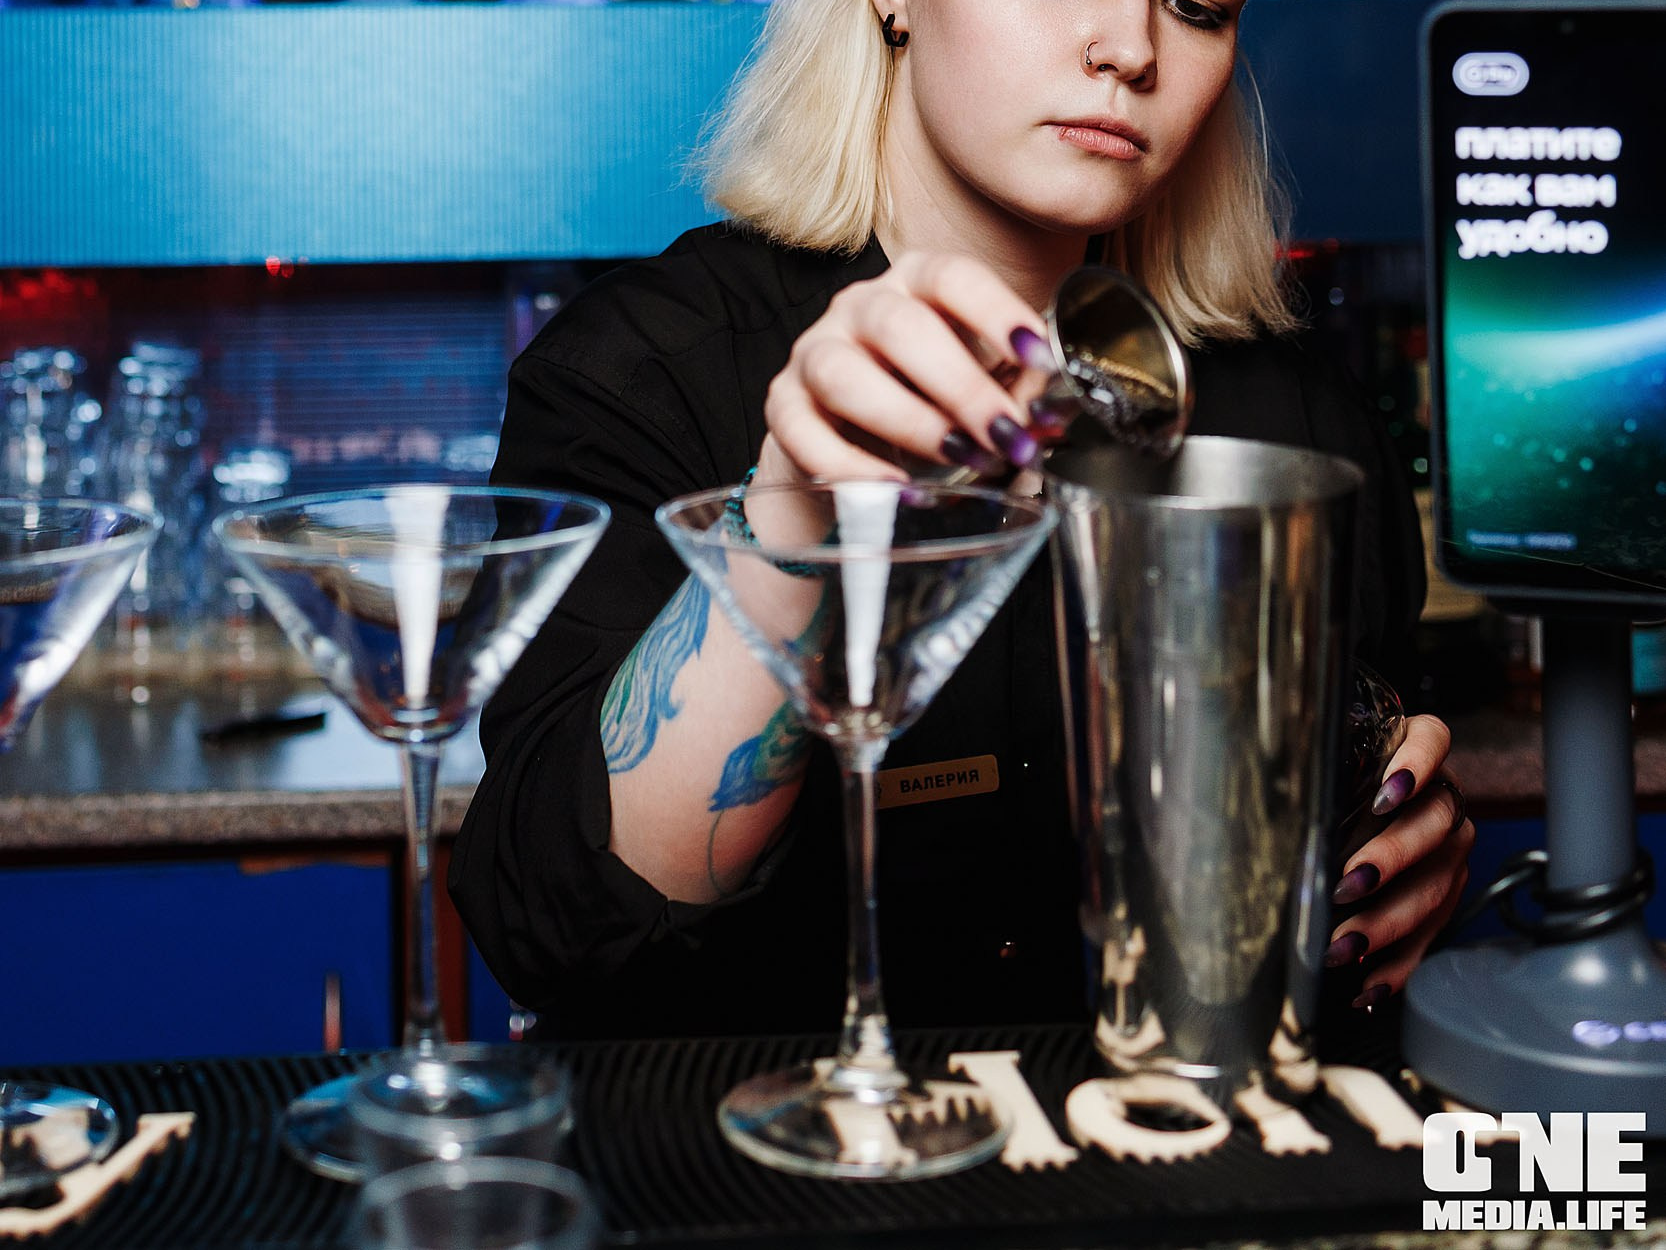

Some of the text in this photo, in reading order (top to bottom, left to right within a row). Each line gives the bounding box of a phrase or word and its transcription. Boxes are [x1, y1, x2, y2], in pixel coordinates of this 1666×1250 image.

[1455, 127, 1622, 161] платите
[1456, 173, 1617, 207] как вам
[1455, 210, 1609, 260] удобно
[900, 769, 980, 793] ВАЛЕРИЯ
